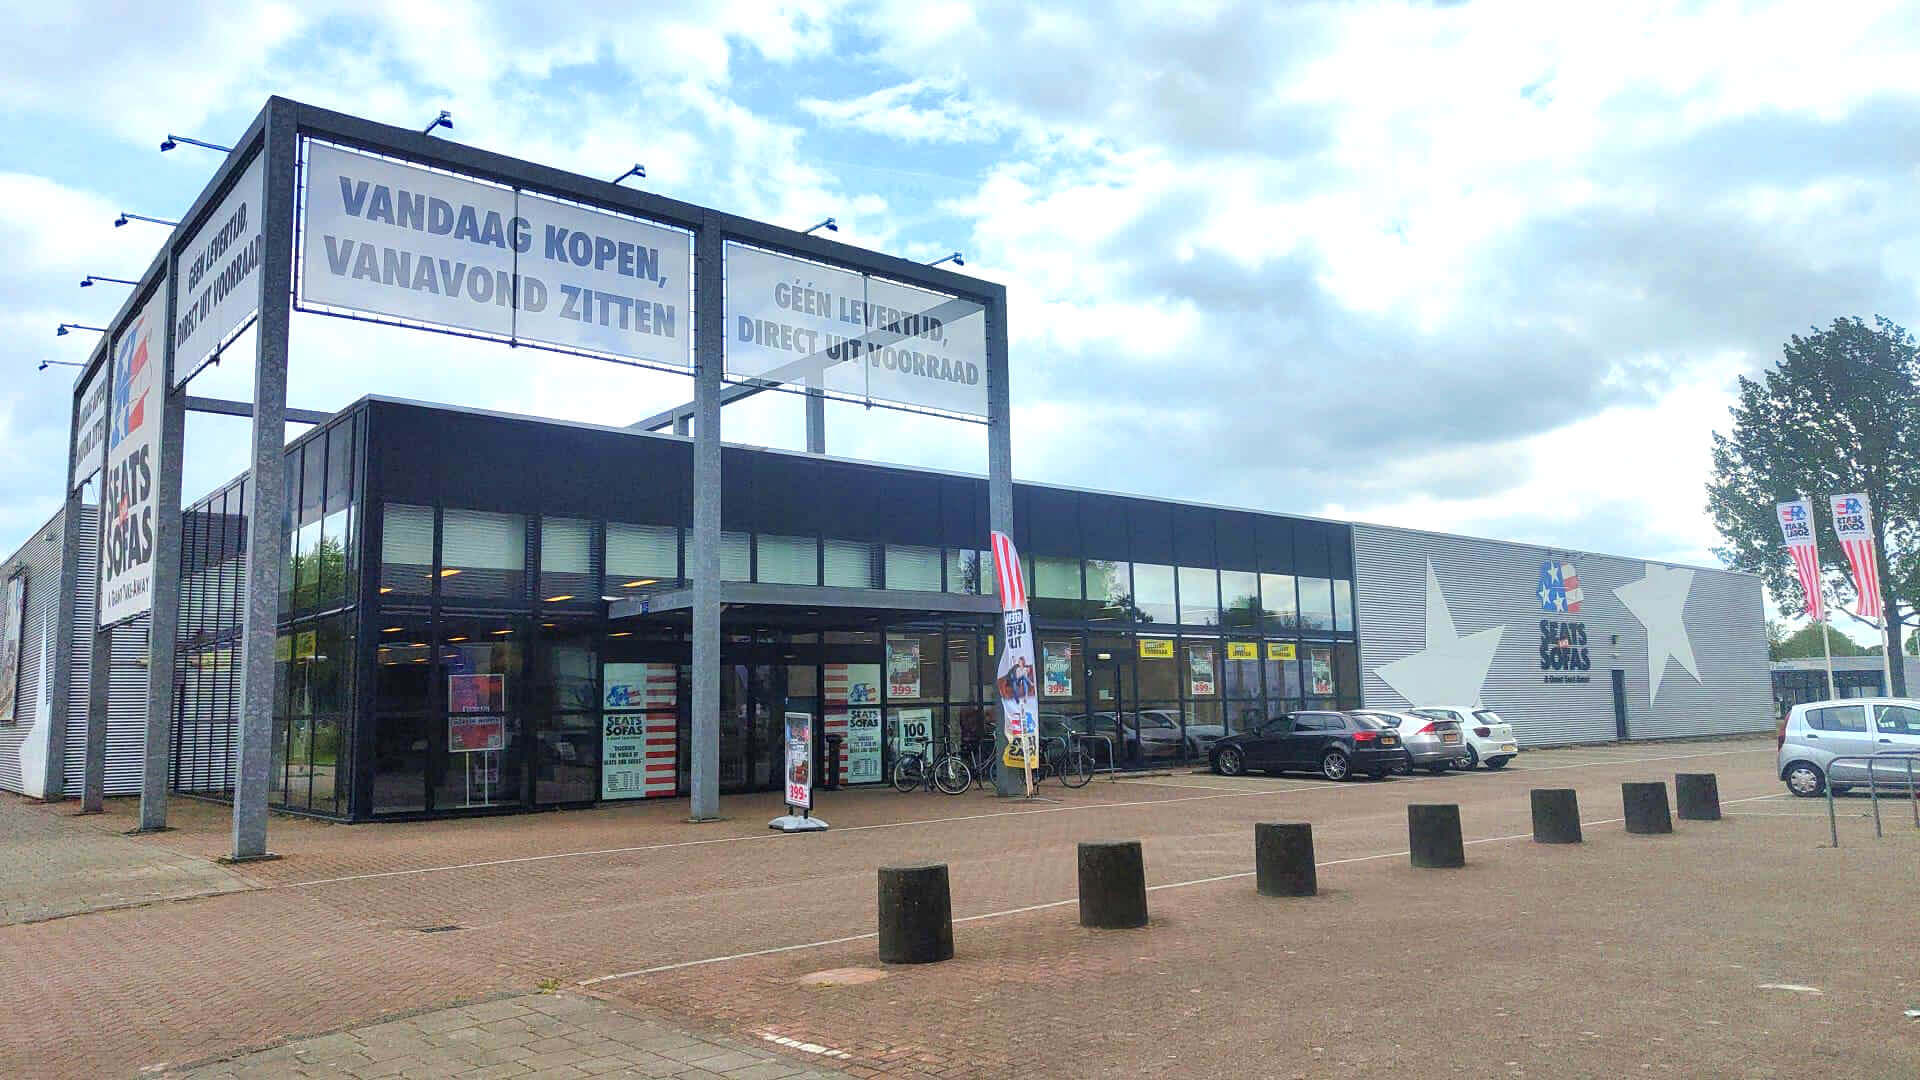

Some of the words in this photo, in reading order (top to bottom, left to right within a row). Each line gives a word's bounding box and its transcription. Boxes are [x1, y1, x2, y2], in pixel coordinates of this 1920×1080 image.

[338, 175, 532, 253] VANDAAG
[544, 223, 667, 289] KOPEN,
[323, 234, 548, 313] VANAVOND
[559, 283, 675, 338] ZITTEN
[177, 302, 199, 349] DIRECT
[200, 285, 212, 323] UIT
[774, 278, 832, 319] GÉÉN
[839, 295, 949, 348] LEVERTIJD,
[737, 315, 819, 355] DIRECT
[825, 333, 862, 362] UIT
[868, 341, 980, 386] VOORRAAD
[108, 443, 151, 519] SEATS
[106, 505, 153, 583] SOFAS
[1539, 619, 1588, 646] SEATS
[1539, 644, 1592, 671] SOFAS
[605, 726, 643, 736] SOFAS
[607, 716, 642, 726] SEATS
[849, 719, 879, 728] SOFAS
[850, 710, 878, 719] SEATS
[903, 722, 926, 737] 100
